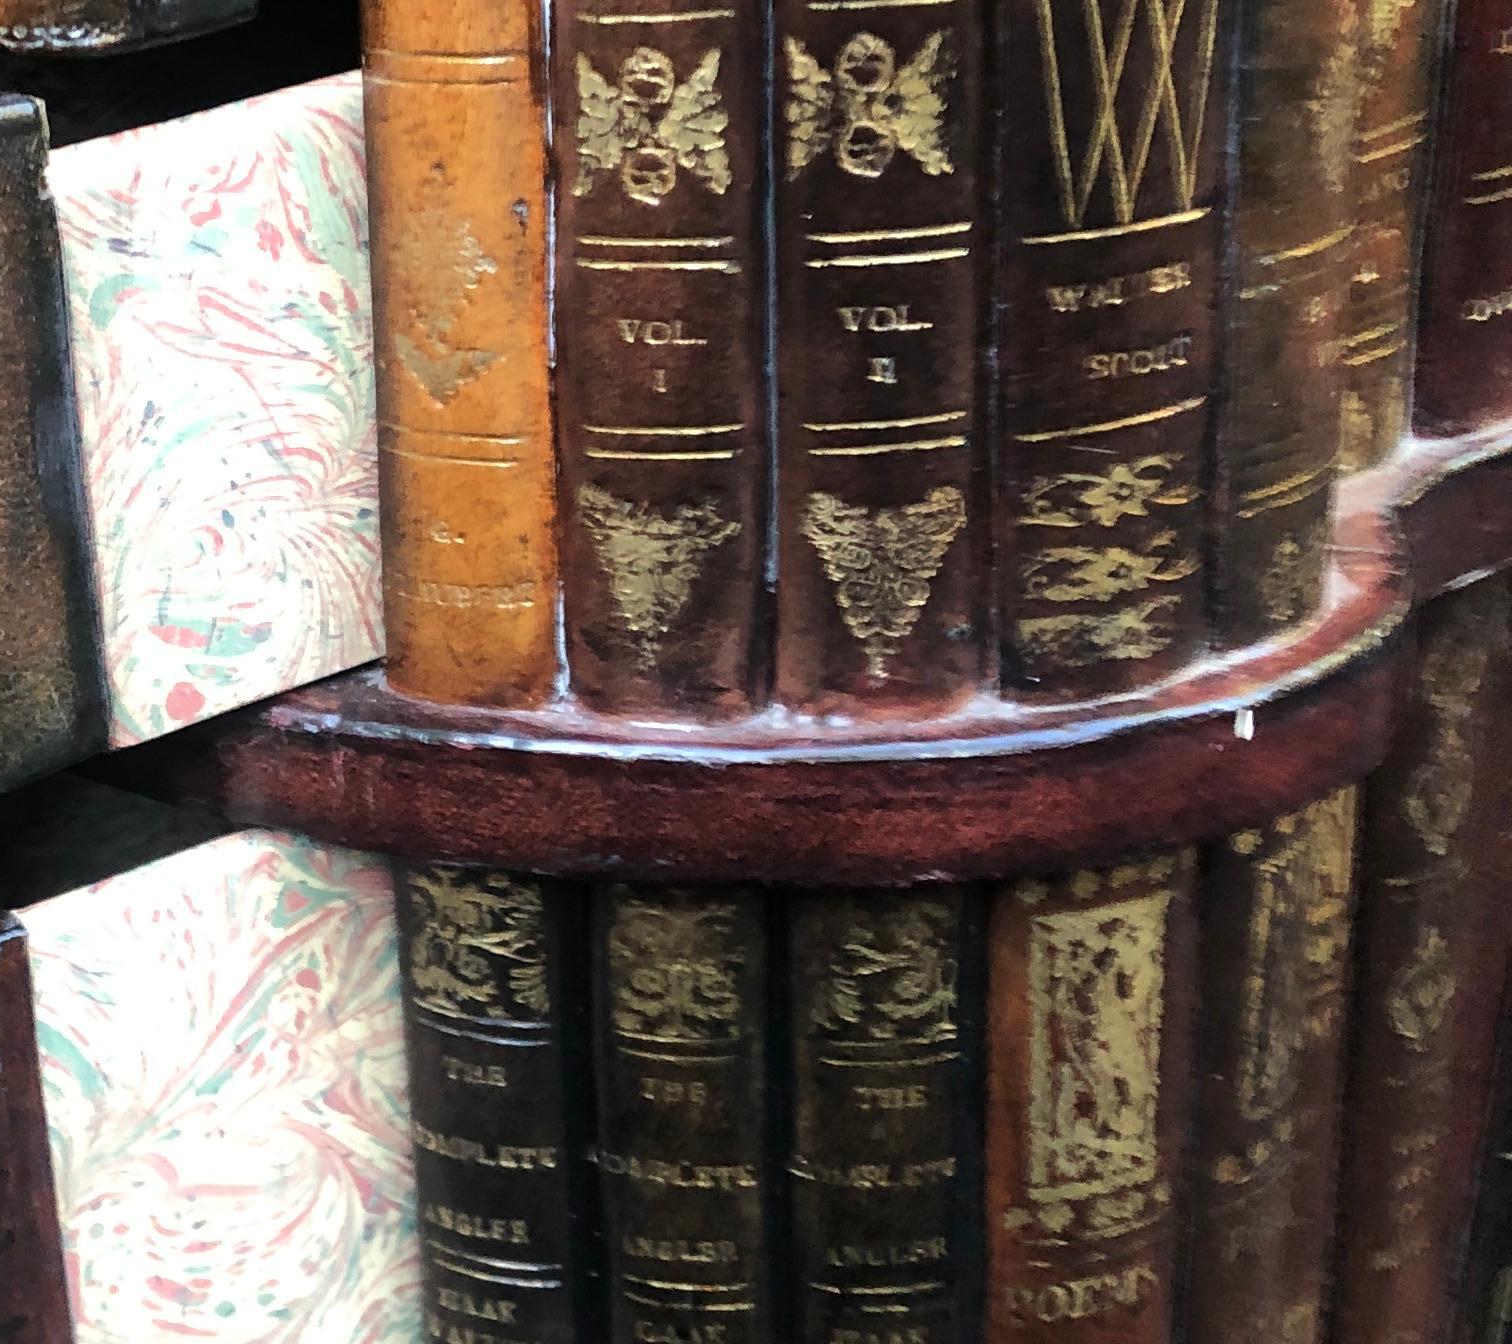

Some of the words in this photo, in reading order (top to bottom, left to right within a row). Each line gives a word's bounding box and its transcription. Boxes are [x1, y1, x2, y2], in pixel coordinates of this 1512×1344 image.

[1045, 261, 1193, 313] WALTER
[441, 1054, 509, 1088] THE
[853, 1084, 929, 1111] THE
[424, 1201, 531, 1244] ANGLER
